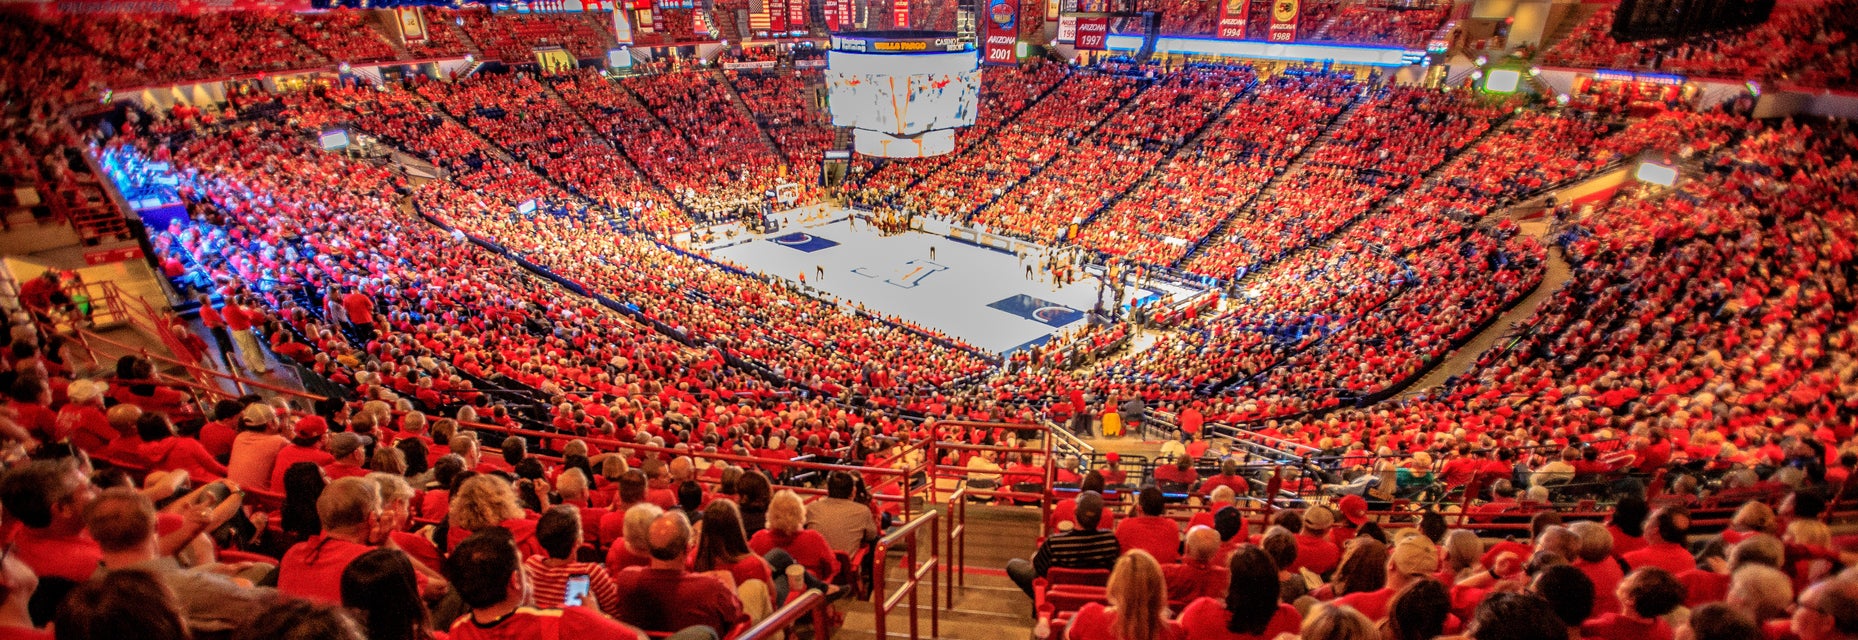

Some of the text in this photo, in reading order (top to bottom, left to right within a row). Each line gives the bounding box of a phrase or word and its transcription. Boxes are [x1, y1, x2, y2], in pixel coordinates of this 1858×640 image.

[1220, 18, 1246, 26] ARIZONA
[1079, 23, 1106, 32] ARIZONA
[1063, 29, 1075, 38] 199
[1222, 28, 1241, 37] 1994
[1272, 32, 1291, 41] 1988
[935, 38, 956, 46] CASINO
[987, 35, 1016, 45] ARIZONA
[1081, 35, 1102, 46] 1997
[874, 42, 900, 50] WELLS
[901, 42, 927, 50] FARGO
[990, 48, 1011, 60] 2001
